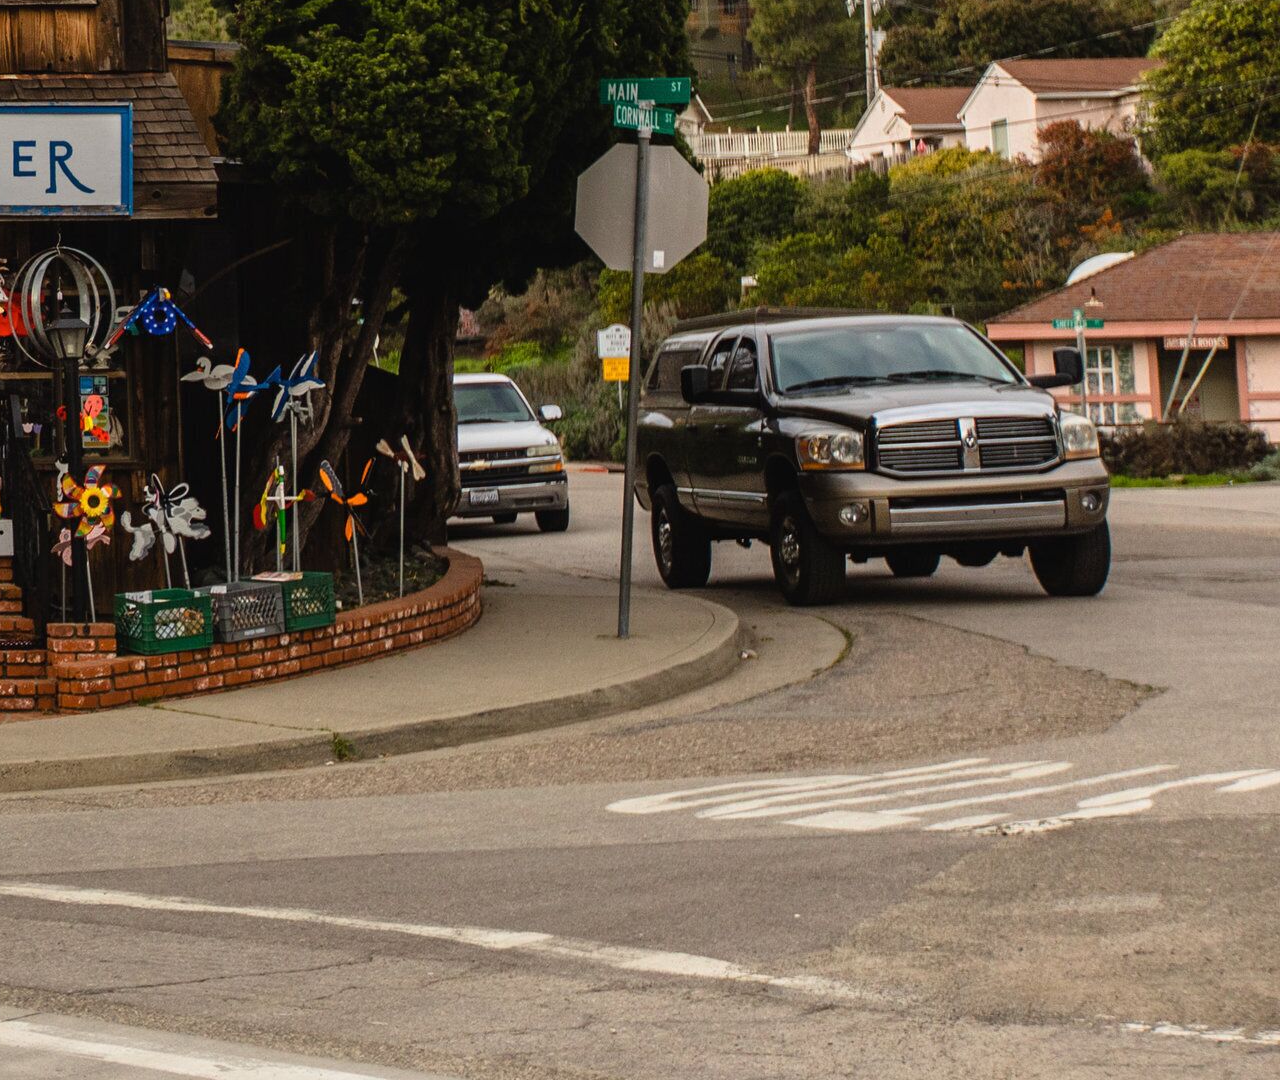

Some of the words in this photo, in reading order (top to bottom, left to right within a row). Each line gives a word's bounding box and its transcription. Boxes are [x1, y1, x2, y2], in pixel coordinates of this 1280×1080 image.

[607, 83, 639, 103] MAIN
[671, 82, 682, 92] ST
[616, 105, 660, 130] CORNWALL
[665, 113, 673, 123] ST
